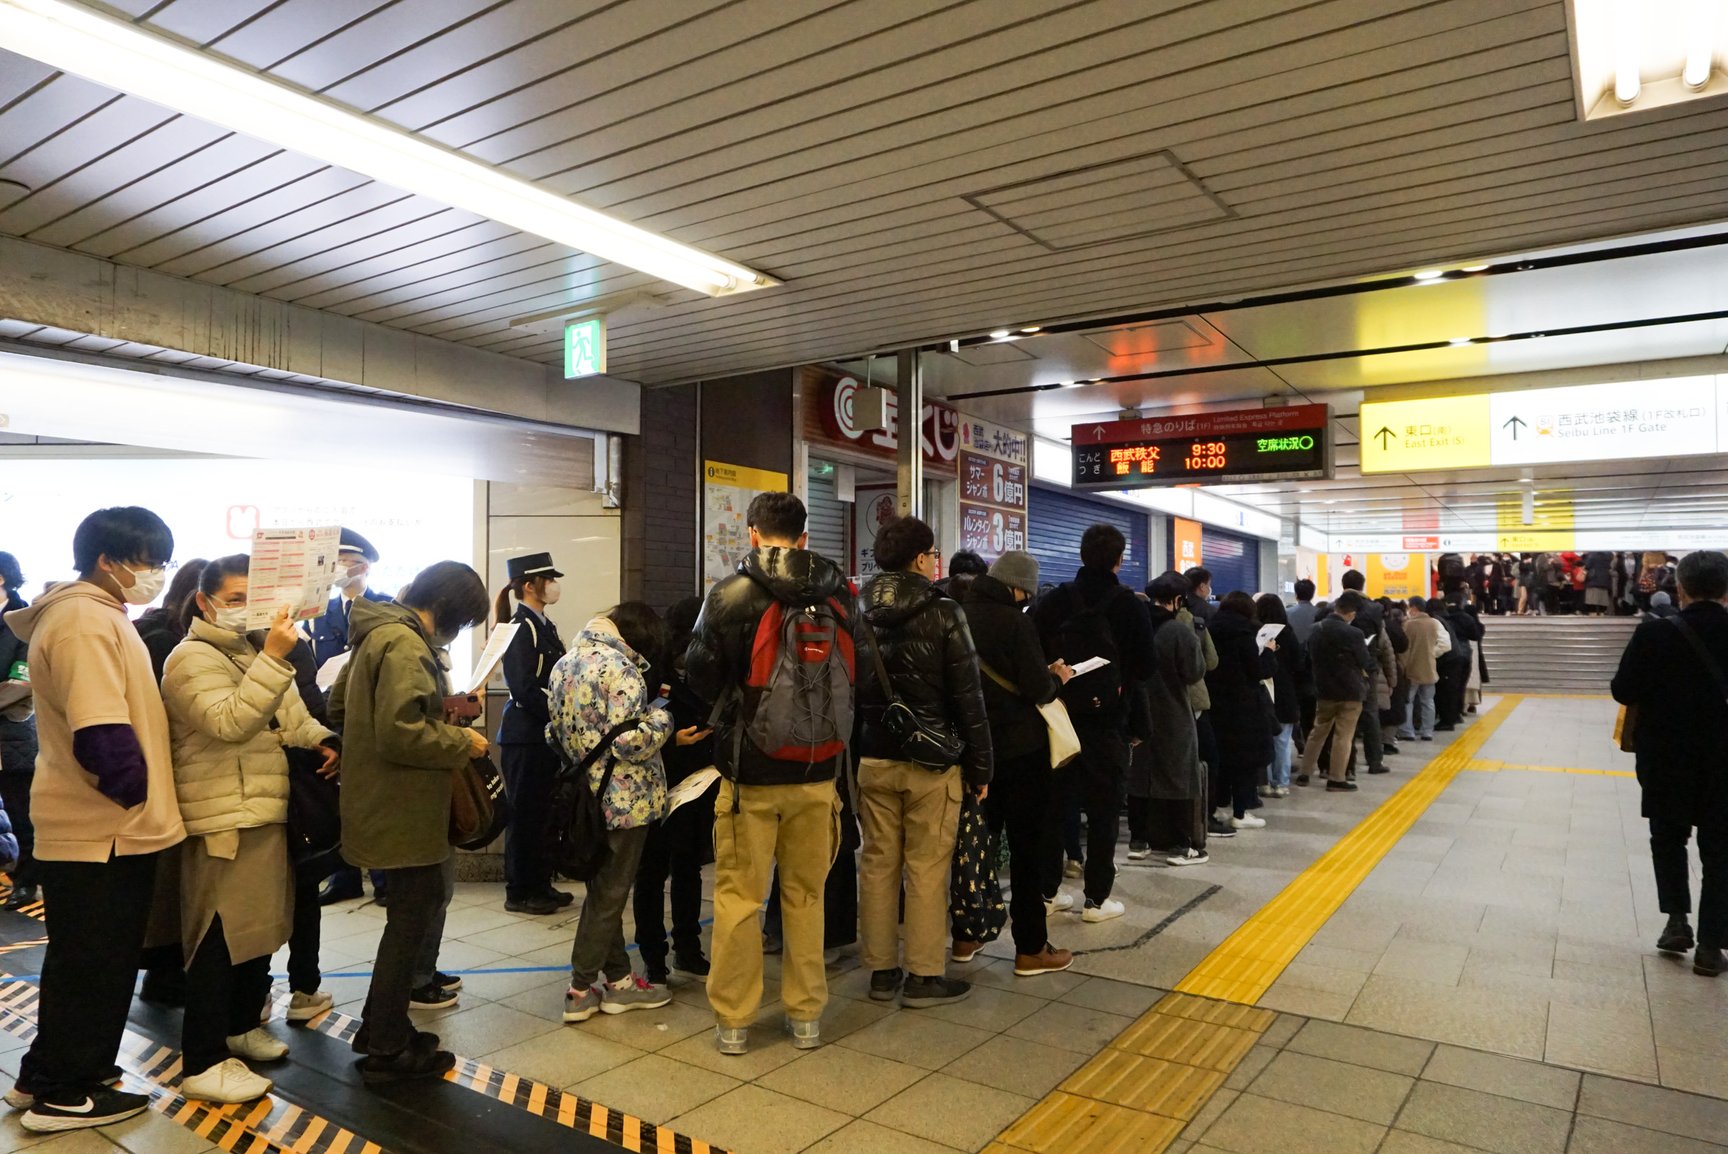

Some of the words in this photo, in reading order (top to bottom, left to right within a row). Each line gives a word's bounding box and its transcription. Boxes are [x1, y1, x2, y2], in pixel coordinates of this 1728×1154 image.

[1240, 413, 1267, 422] Express
[1269, 411, 1299, 419] Platform
[1558, 427, 1590, 439] Seibu
[1593, 426, 1617, 437] Line
[1622, 424, 1633, 434] 1F
[1638, 422, 1667, 434] Gate
[1192, 442, 1226, 456] 9:30
[1405, 439, 1426, 449] East
[1429, 437, 1449, 447] Exit
[1079, 452, 1100, 463] こんど
[1110, 446, 1160, 462] 西武秩父
[1116, 460, 1154, 475] 飯能
[1185, 455, 1226, 470] 10:00
[970, 464, 985, 481] サマー
[966, 480, 988, 498] ジャンボ
[966, 533, 988, 550] ジャンボ
